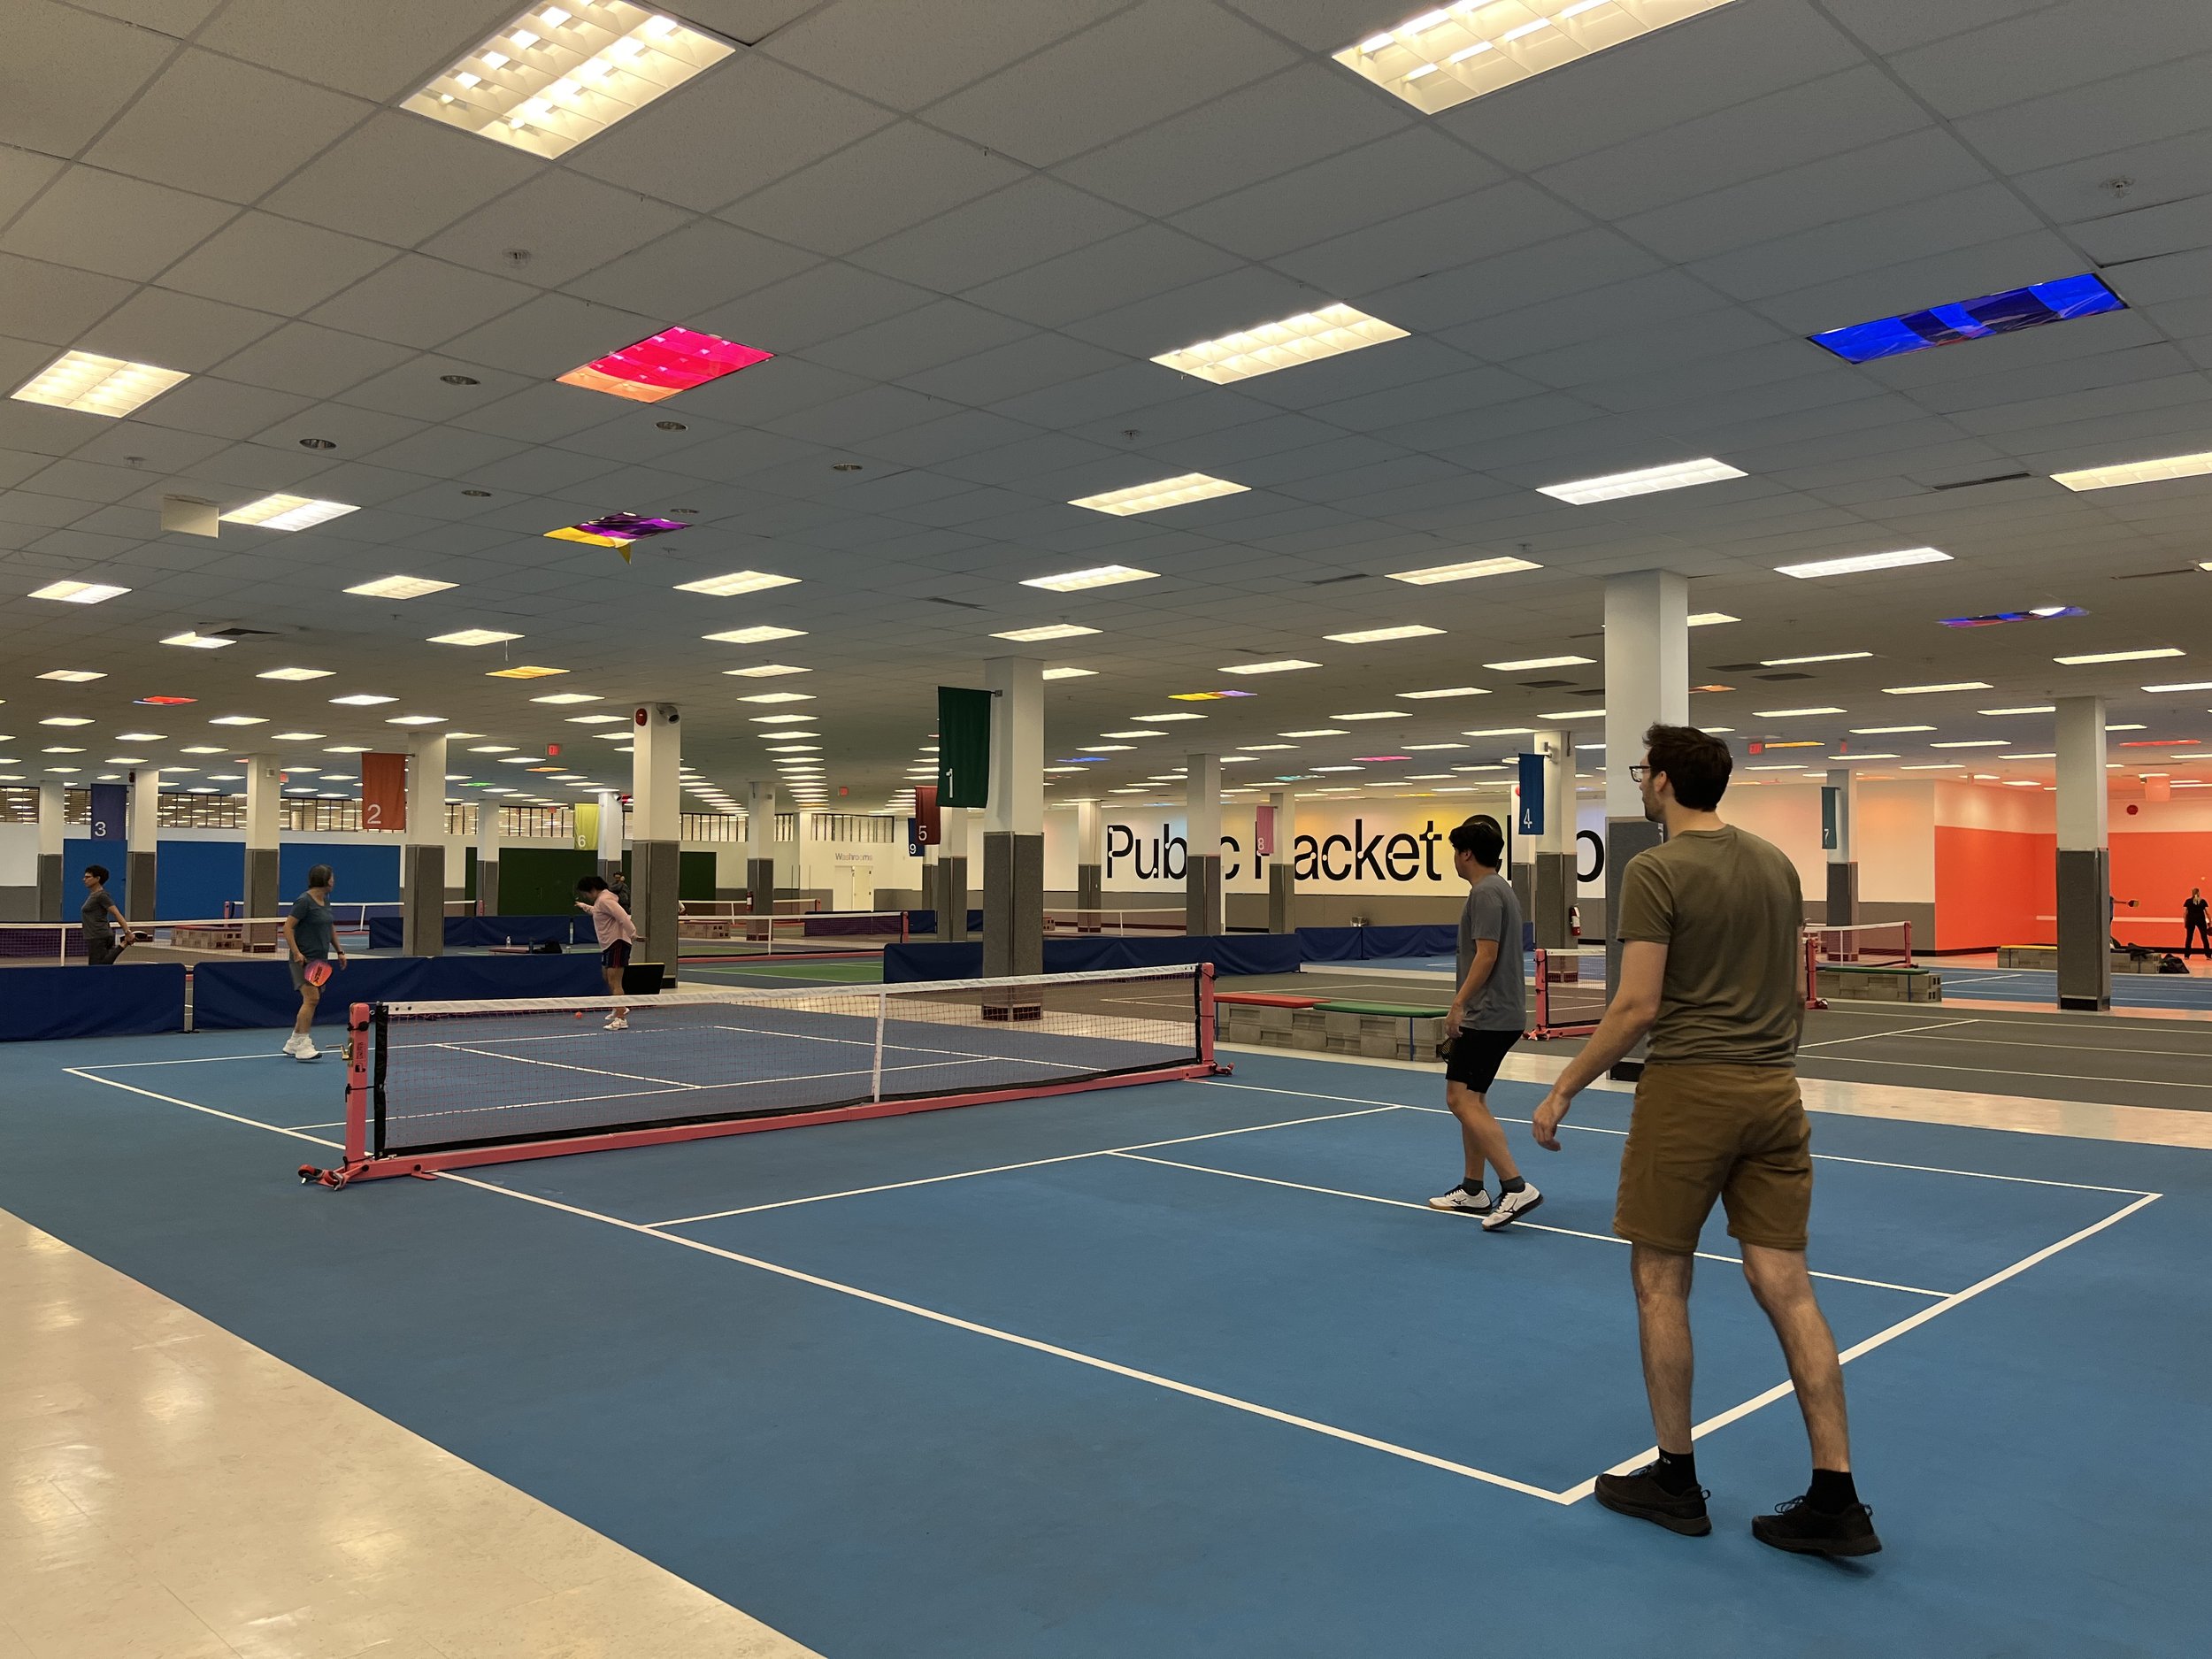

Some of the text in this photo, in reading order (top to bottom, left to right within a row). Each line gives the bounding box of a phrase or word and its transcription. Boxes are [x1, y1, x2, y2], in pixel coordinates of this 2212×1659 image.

[946, 768, 953, 798] 1
[367, 803, 381, 824] 2
[1524, 808, 1532, 829] 4
[95, 821, 106, 837] 3
[918, 825, 927, 841] 5
[1824, 828, 1829, 845] 7
[578, 834, 586, 848] 6
[910, 843, 917, 855] 9
[1257, 837, 1264, 850] 8
[1107, 823, 1240, 880] Pubc
